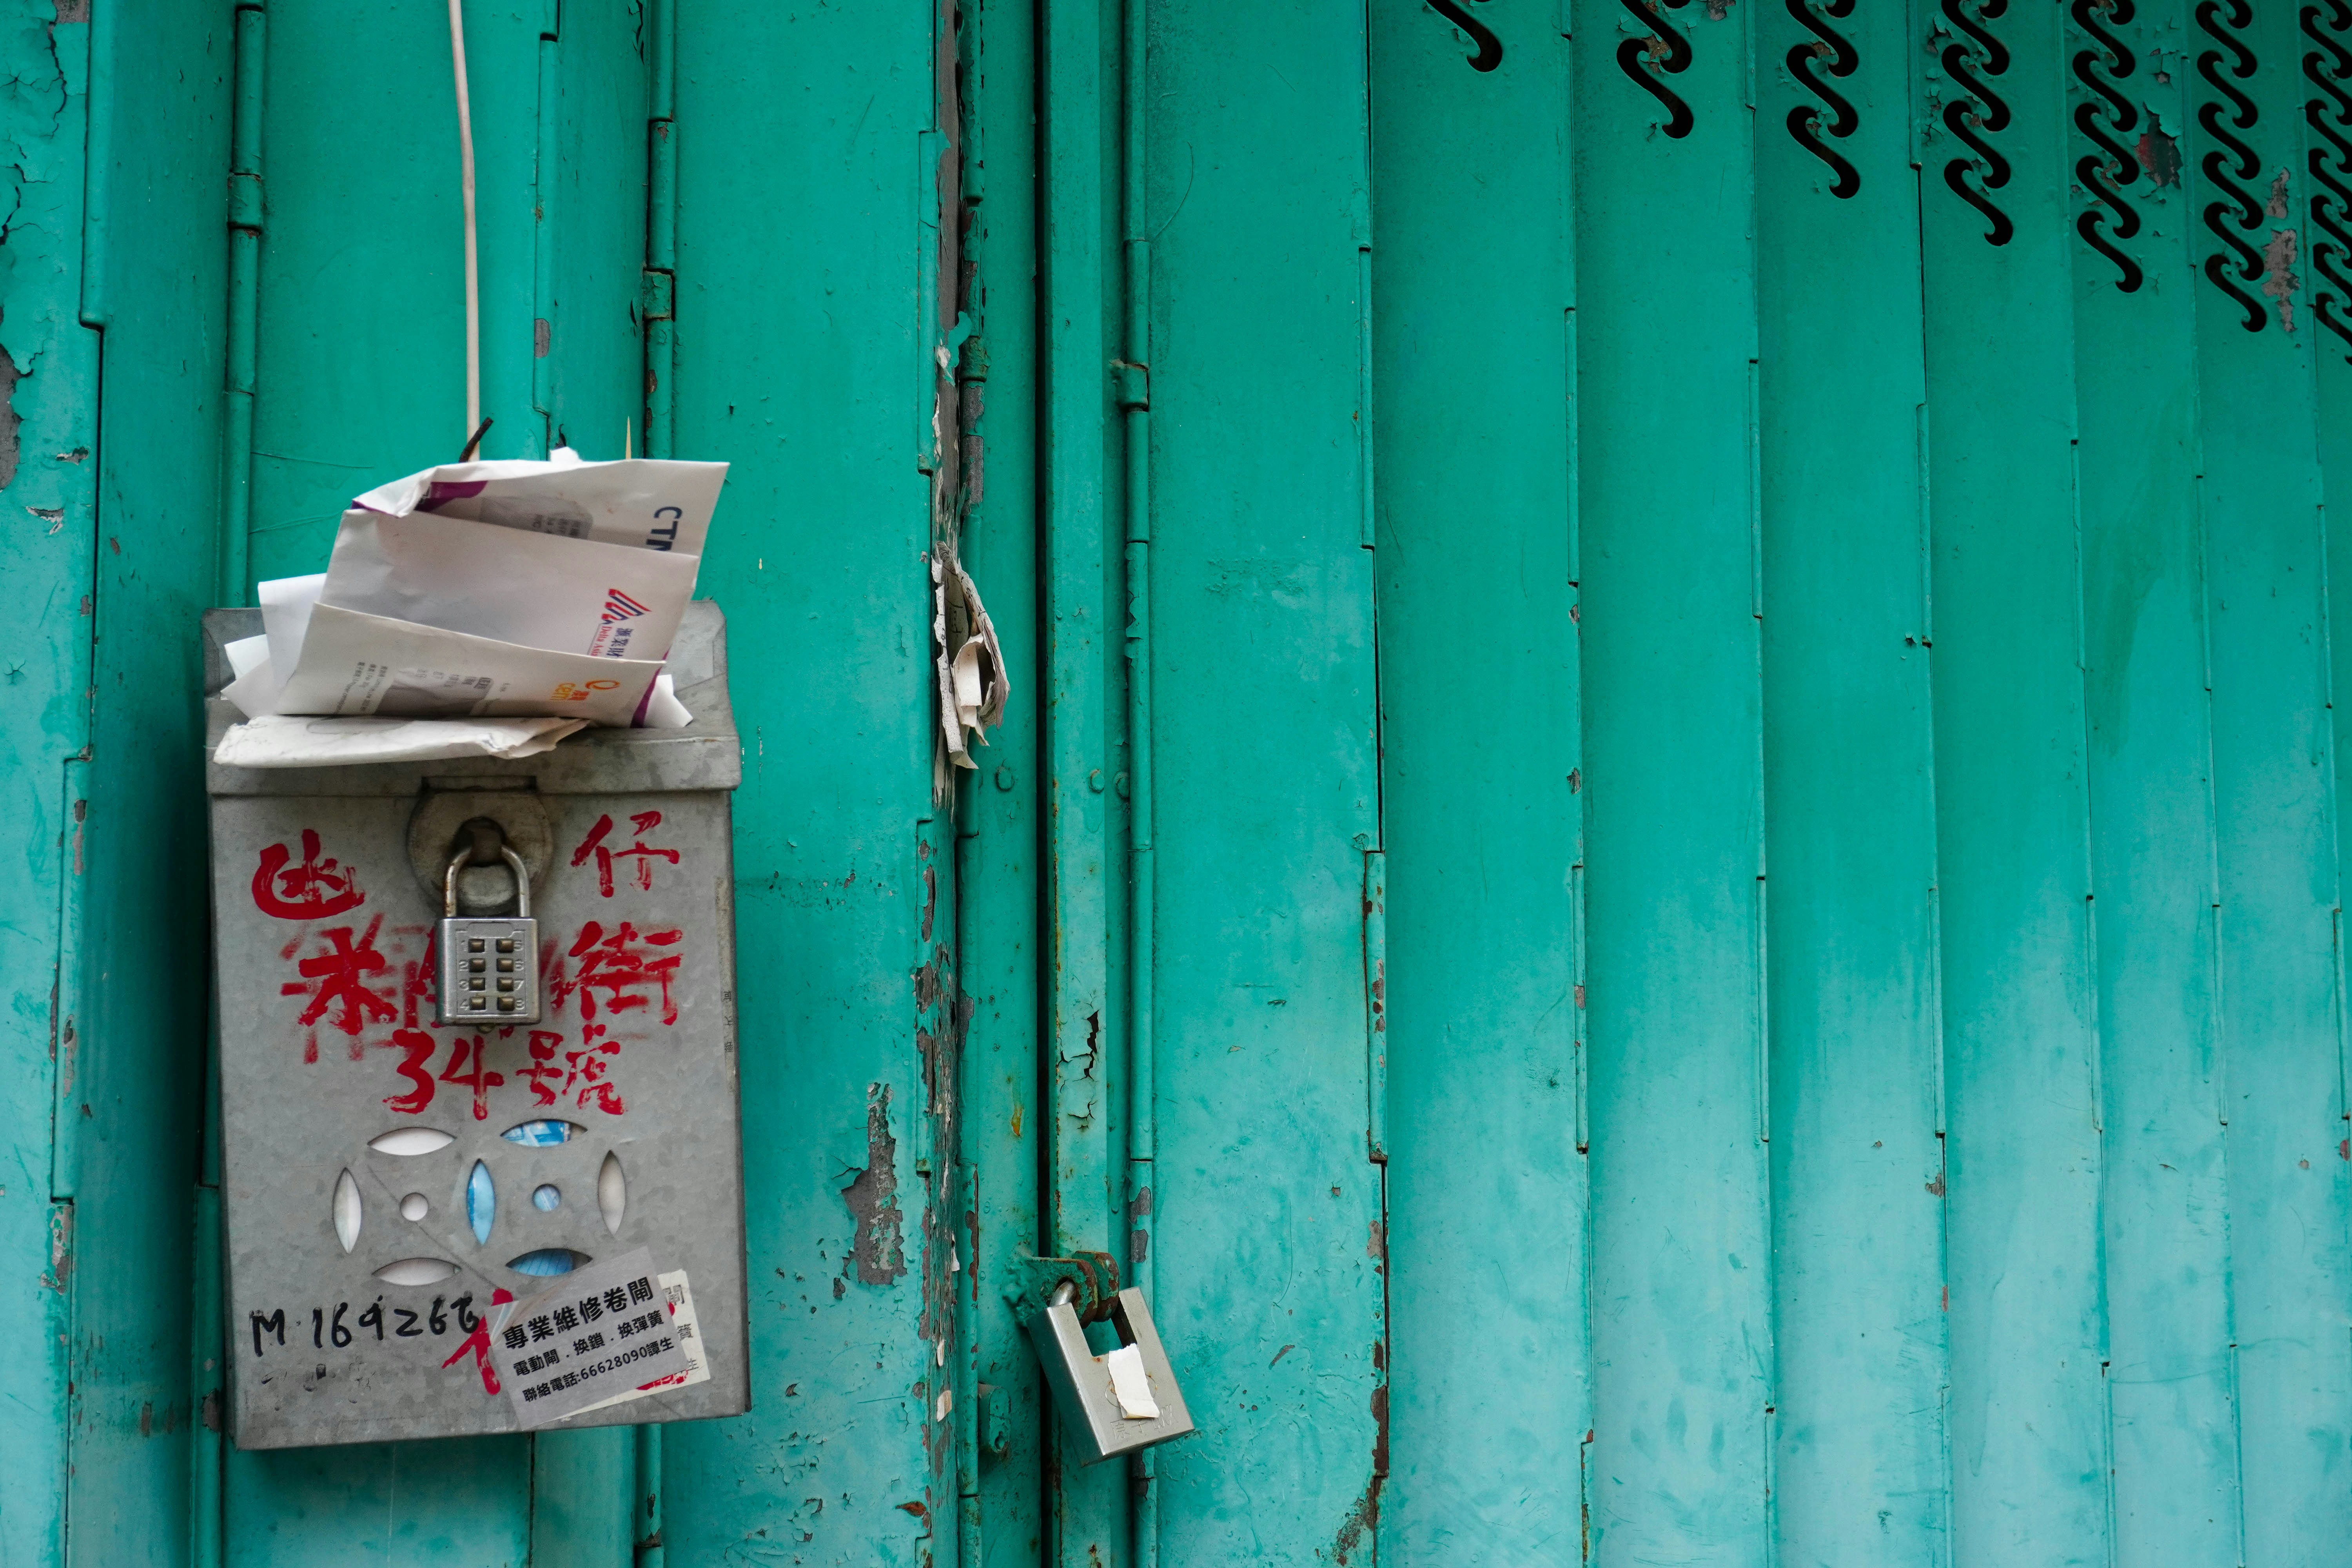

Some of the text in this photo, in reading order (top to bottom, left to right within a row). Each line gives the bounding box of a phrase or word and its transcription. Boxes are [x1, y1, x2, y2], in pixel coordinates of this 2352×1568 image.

[596, 626, 612, 642] Delta
[459, 960, 469, 971] 2
[514, 979, 524, 991] 7
[502, 1277, 653, 1349] 專業維修卷閘
